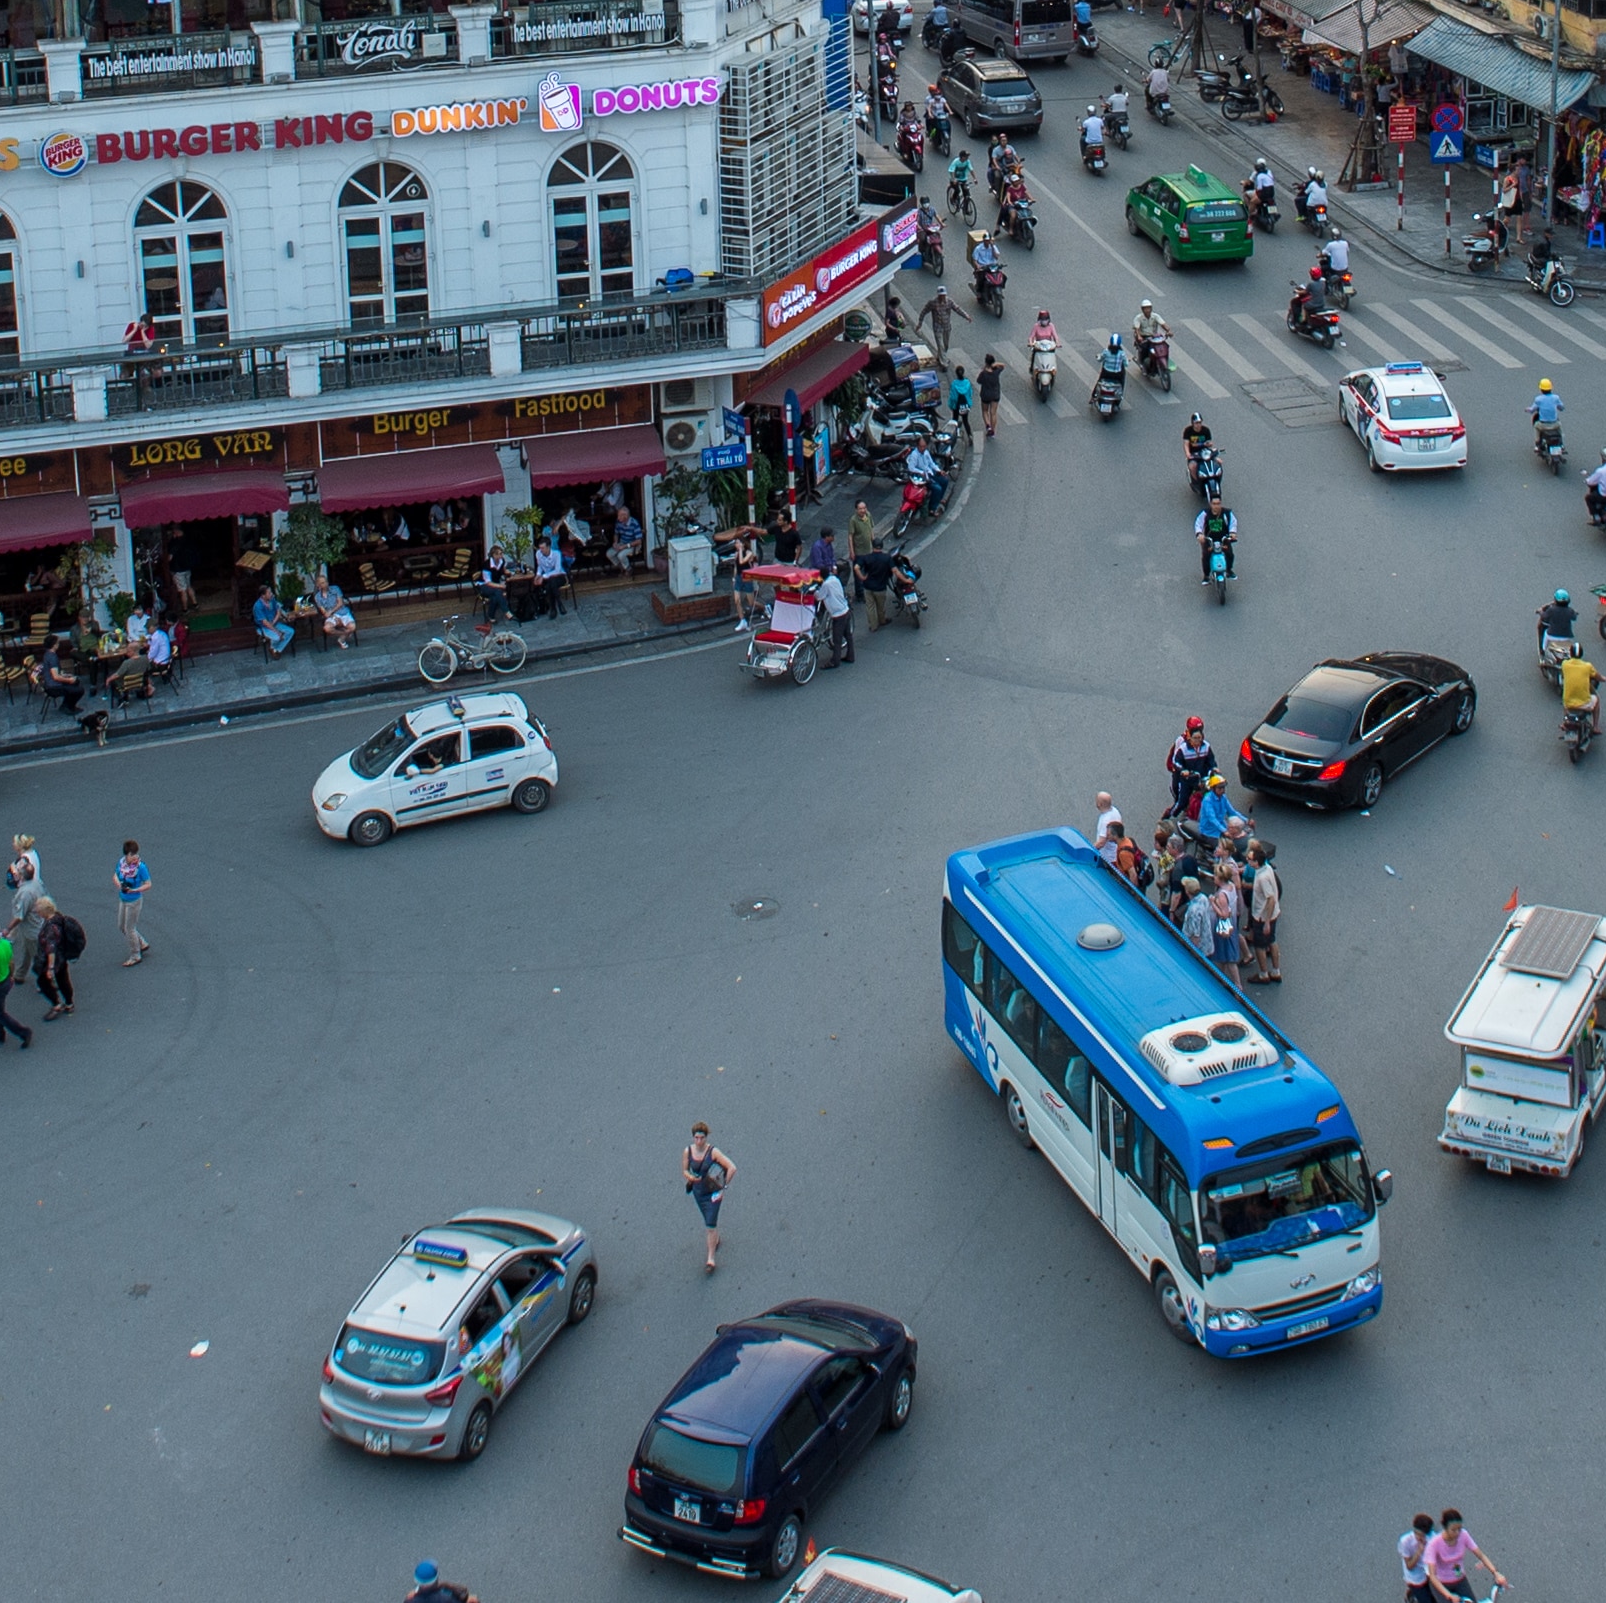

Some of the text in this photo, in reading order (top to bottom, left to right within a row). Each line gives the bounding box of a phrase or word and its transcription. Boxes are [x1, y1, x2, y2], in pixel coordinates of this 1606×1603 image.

[525, 20, 546, 42] best
[546, 15, 607, 40] entertainment
[607, 14, 629, 36] show
[630, 13, 639, 34] in
[639, 10, 666, 32] Hanoi
[88, 45, 256, 78] The best entertainment show in Hanoi
[594, 76, 718, 115] DONUTS
[394, 99, 528, 136] DUNKIN'
[44, 137, 81, 159] BURGER
[97, 110, 374, 165] BURGER KING
[47, 146, 84, 169] KING
[830, 253, 860, 281] BURGER
[859, 240, 878, 261] KING
[515, 388, 606, 418] Fastfood
[373, 407, 450, 434] Burger
[129, 440, 203, 468] LONG
